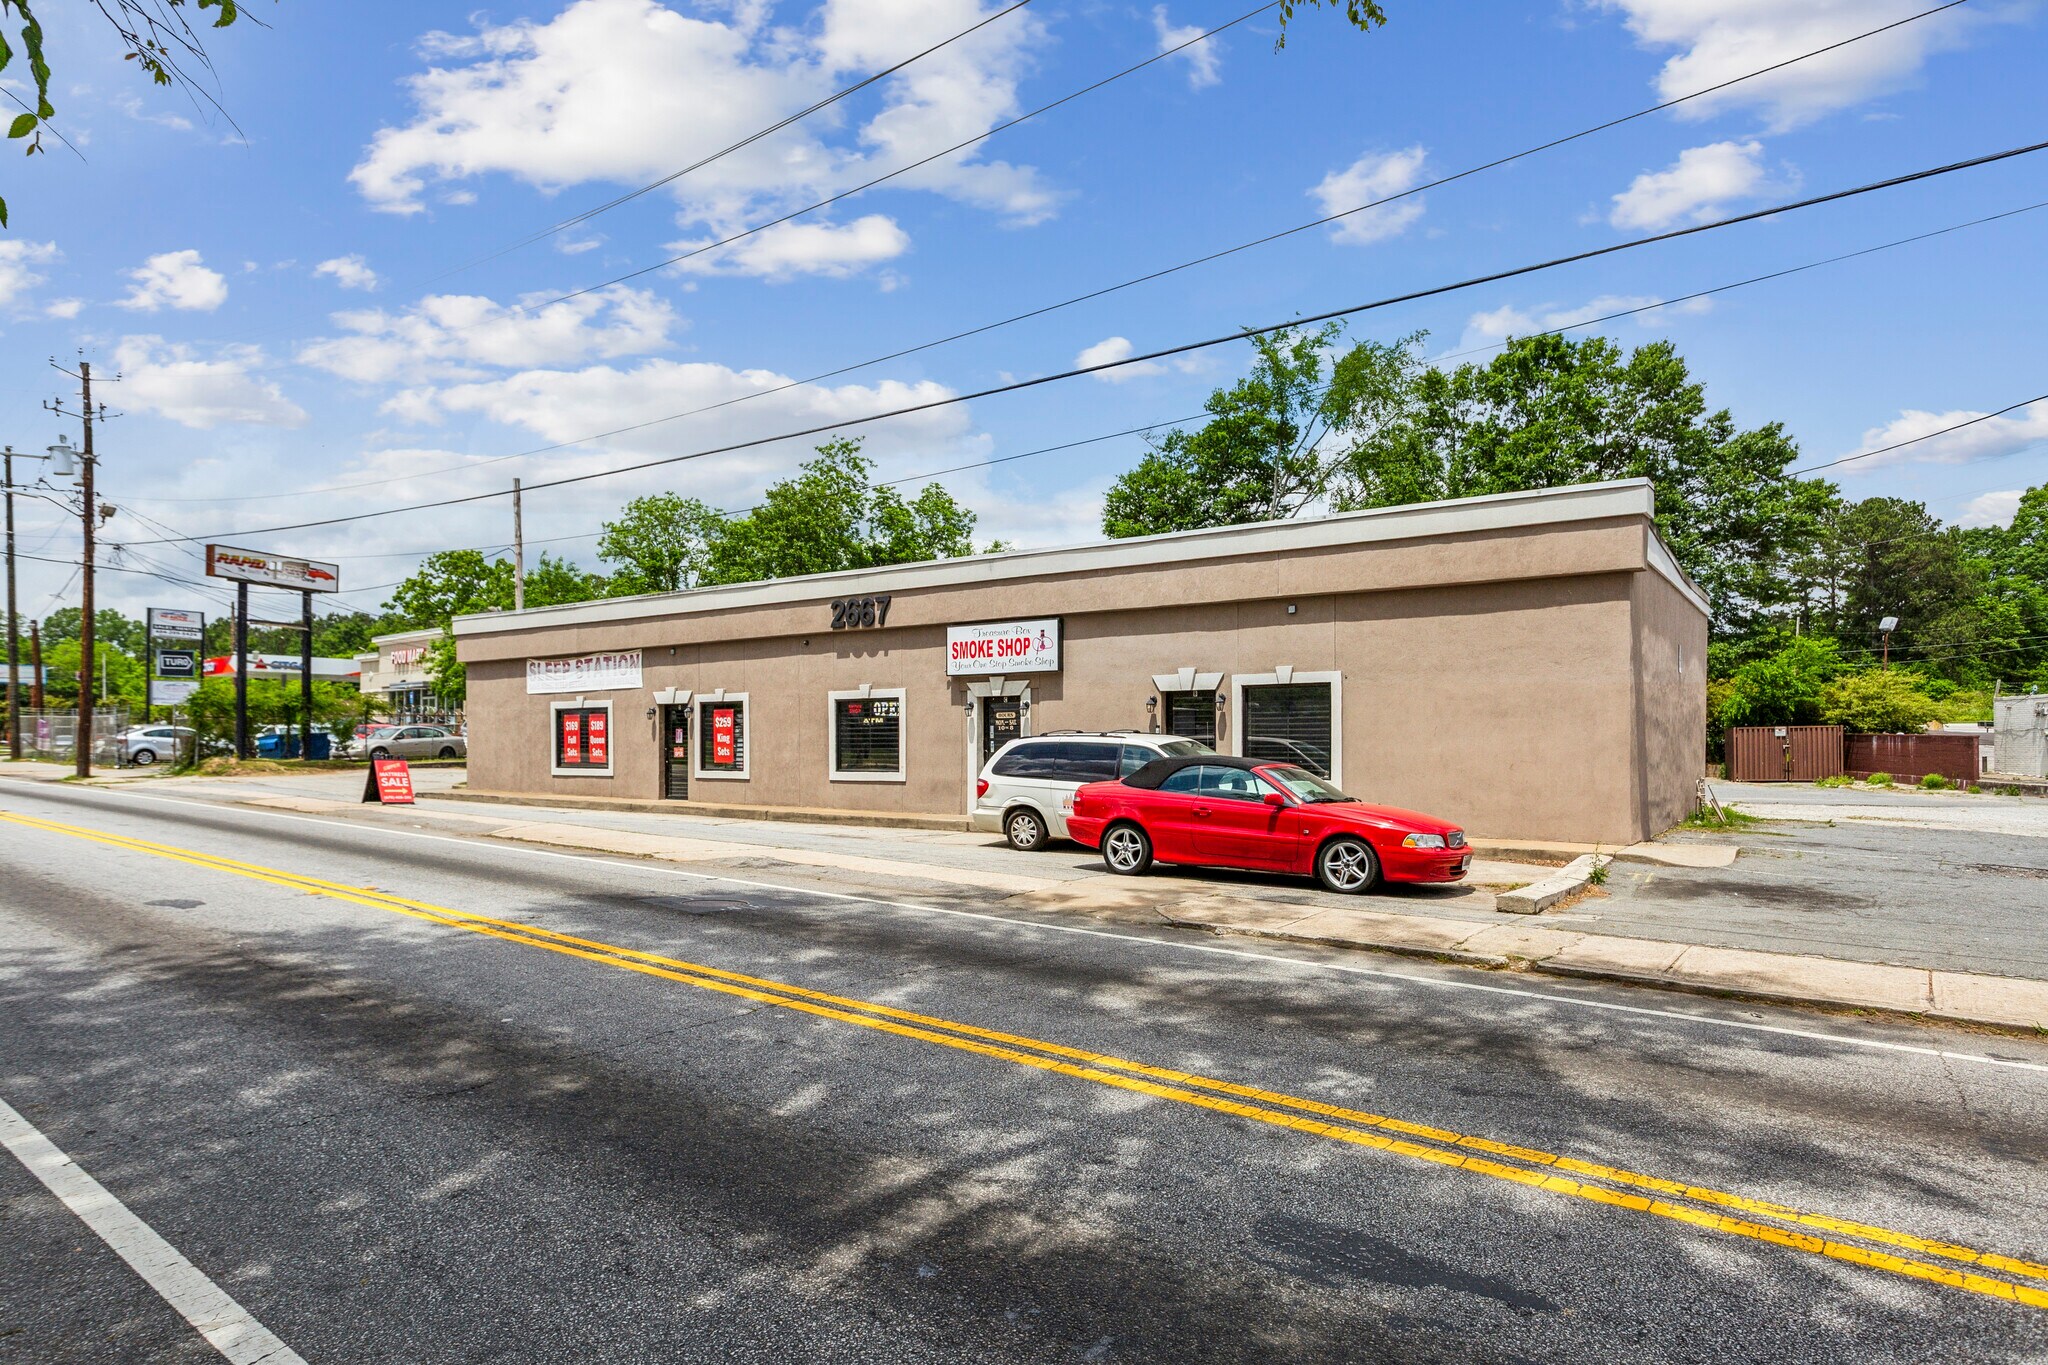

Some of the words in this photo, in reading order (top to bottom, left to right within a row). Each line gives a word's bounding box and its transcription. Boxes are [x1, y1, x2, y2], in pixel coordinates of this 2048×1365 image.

[216, 553, 266, 569] RAPID
[831, 595, 892, 628] 2667
[952, 640, 994, 660] SMOKE
[997, 637, 1031, 657] SHOP
[390, 650, 407, 665] FOOD
[1034, 657, 1055, 667] Shop
[575, 653, 640, 677] STATION
[715, 716, 732, 728] $259
[717, 733, 731, 745] King
[717, 747, 730, 756] Sets
[381, 778, 409, 787] SALE
